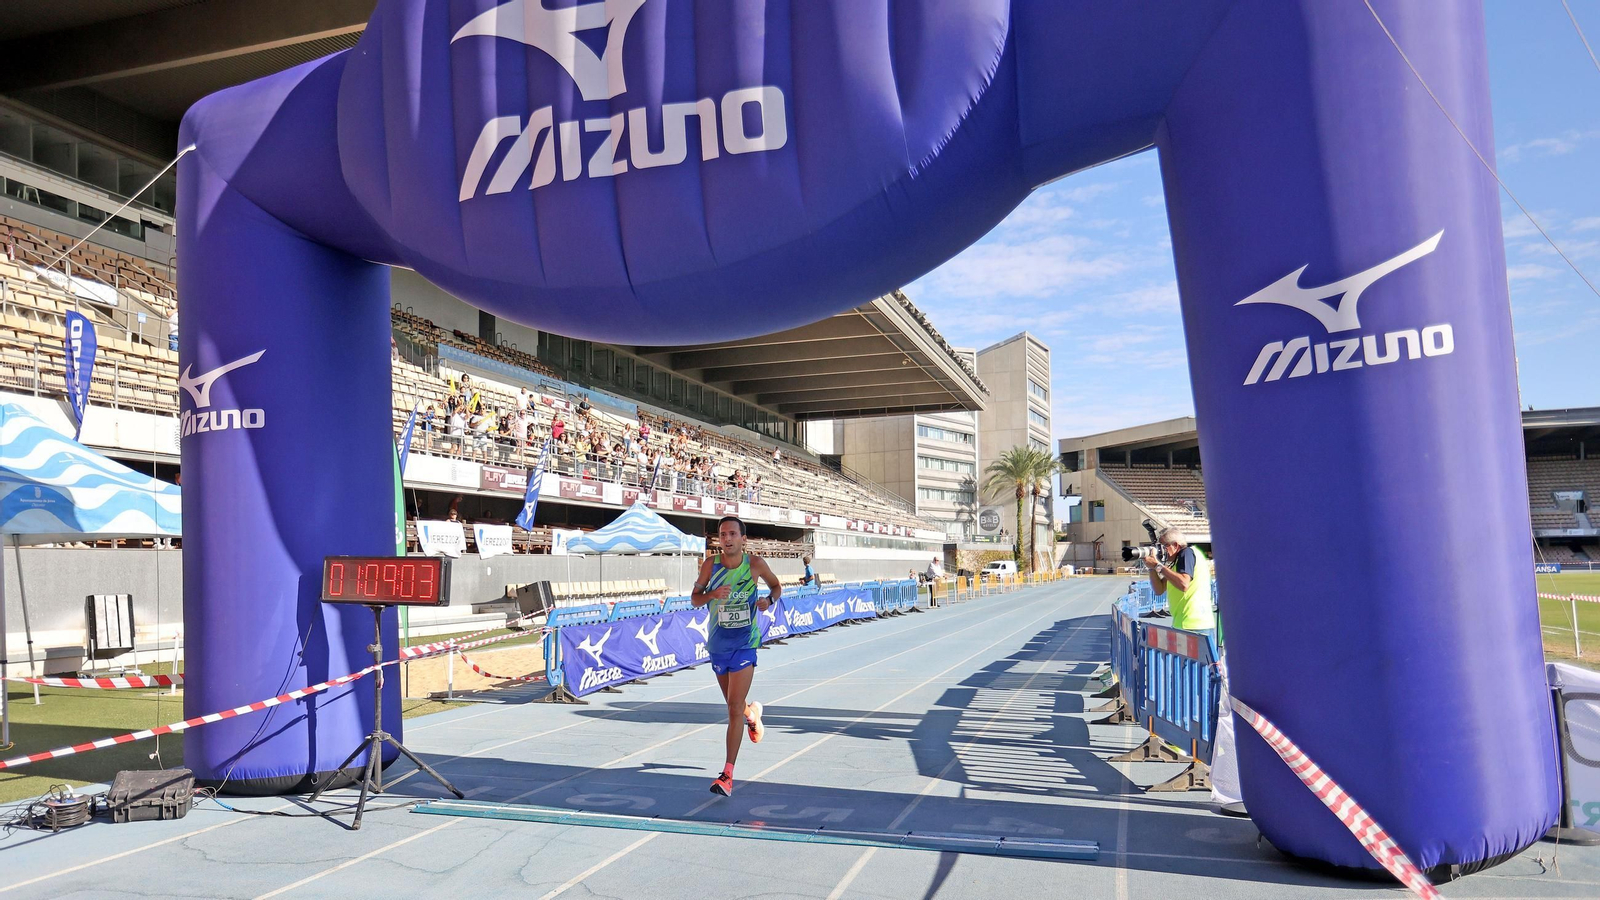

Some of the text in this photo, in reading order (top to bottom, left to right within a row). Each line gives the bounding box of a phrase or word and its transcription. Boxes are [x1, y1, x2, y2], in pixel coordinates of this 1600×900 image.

[484, 471, 504, 482] PLAY
[562, 482, 580, 492] PLAY
[728, 612, 741, 621] 20
